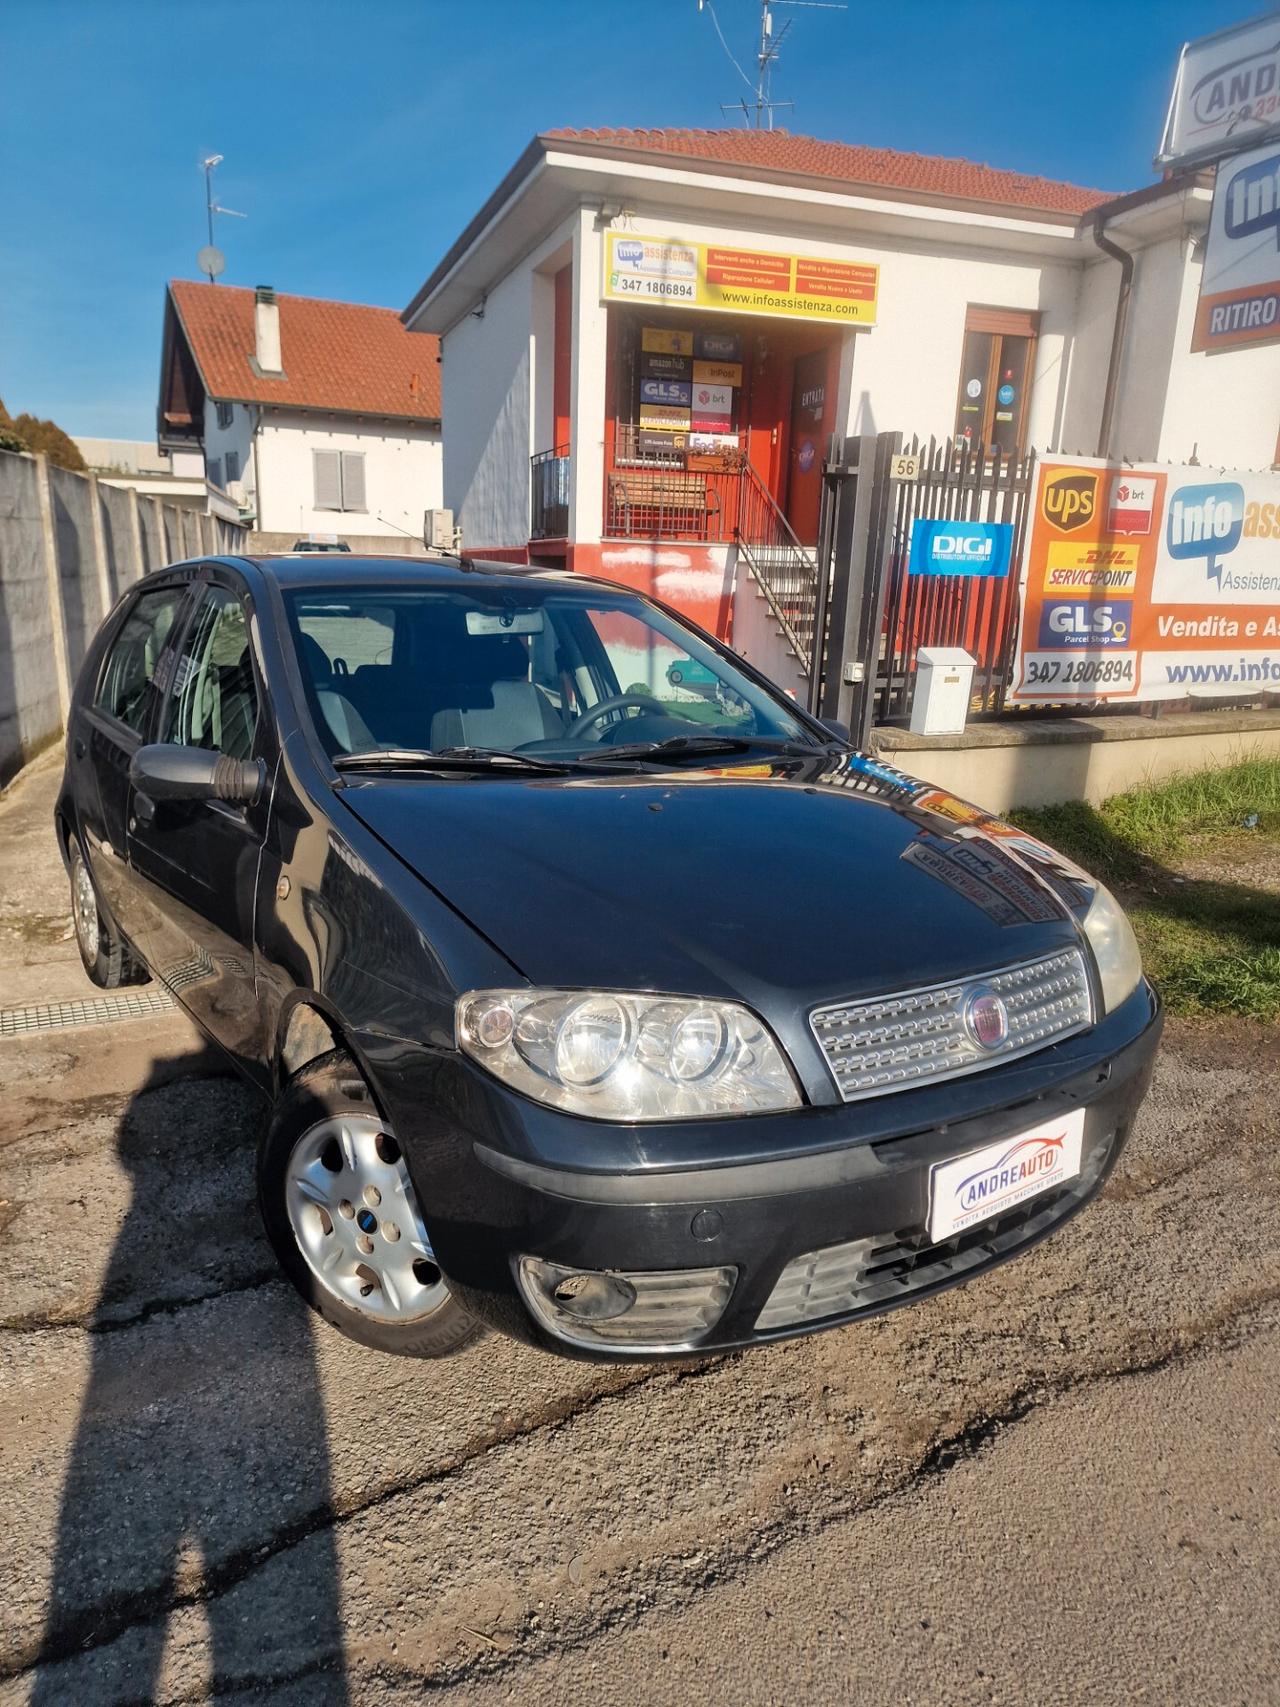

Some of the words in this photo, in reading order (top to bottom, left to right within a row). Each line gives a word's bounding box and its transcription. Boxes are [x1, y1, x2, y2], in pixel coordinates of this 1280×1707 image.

[644, 247, 694, 263] assistenza
[739, 256, 755, 265] anche
[722, 272, 753, 284] Riparazione
[622, 279, 642, 291] 347
[646, 281, 693, 297] 1806894
[721, 292, 858, 315] www.infoassistenza.com
[1210, 296, 1276, 334] RITIRO
[710, 368, 735, 378] InPost
[644, 382, 680, 398] GLS
[712, 394, 726, 404] brt
[897, 459, 915, 475] 56
[1132, 489, 1144, 500] brt
[1048, 486, 1094, 523] ups
[1171, 495, 1234, 546] Info
[932, 536, 993, 555] DIGI
[931, 553, 966, 561] DISTRIBUTORE
[1083, 550, 1128, 565] DHL
[1049, 568, 1132, 587] SERVICEPOINT
[1048, 606, 1113, 633] GLS
[1158, 615, 1238, 637] Vendita
[1245, 620, 1258, 637] e
[1065, 635, 1089, 643] Parcel
[1091, 635, 1110, 645] Shop
[1028, 661, 1061, 684] 347
[1061, 659, 1133, 684] 1806894
[968, 1149, 1054, 1204] ANDREAUTO
[952, 1214, 979, 1229] VENDITA
[982, 1198, 1012, 1216] ACQUISTO
[1014, 1183, 1044, 1201] MACCHINE
